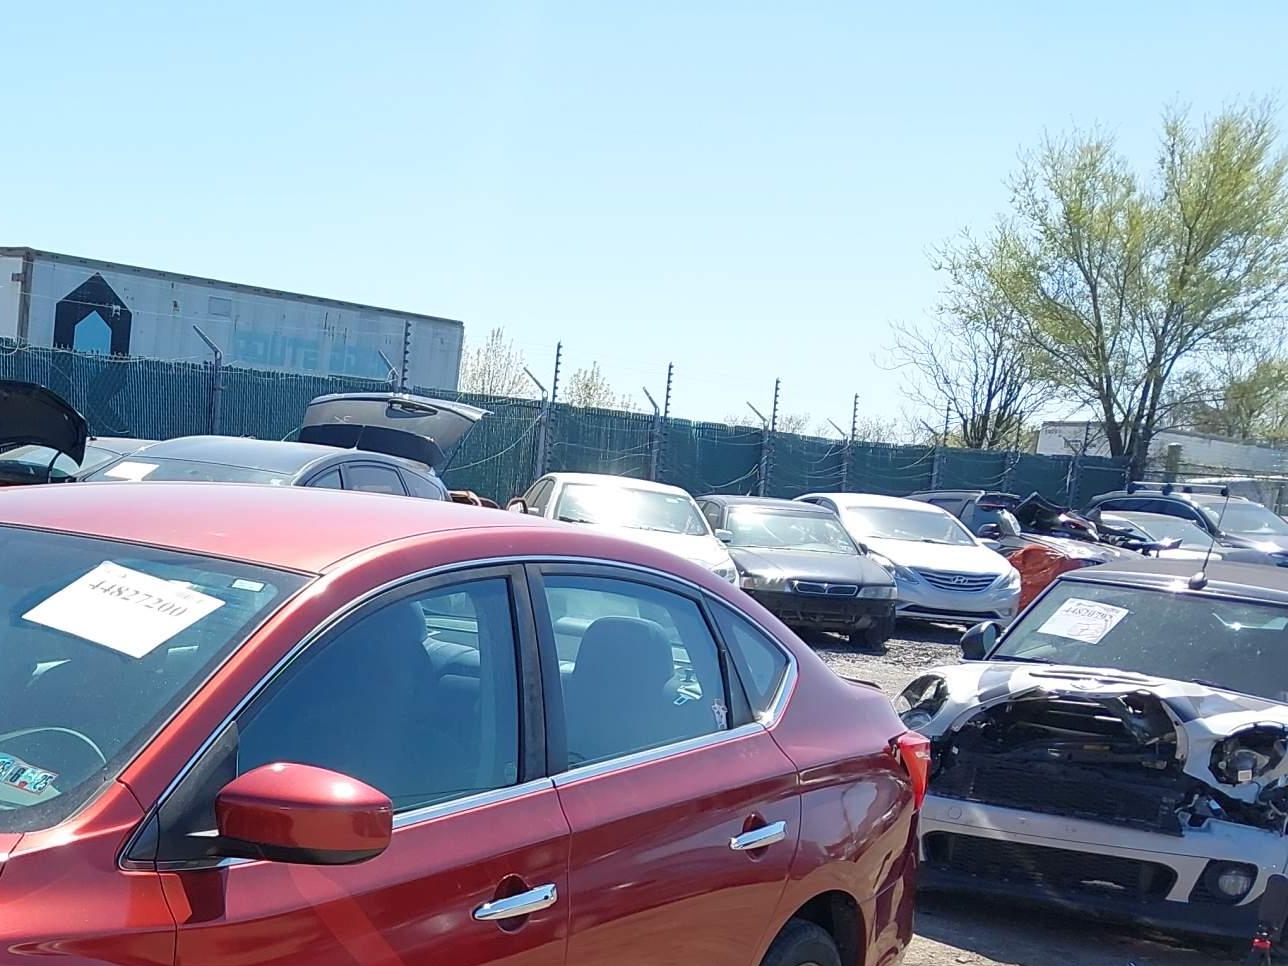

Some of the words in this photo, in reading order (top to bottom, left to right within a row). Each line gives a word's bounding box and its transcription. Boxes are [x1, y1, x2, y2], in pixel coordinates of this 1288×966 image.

[89, 580, 188, 617] 44827200
[9, 767, 26, 783] 6
[32, 774, 54, 791] 25
